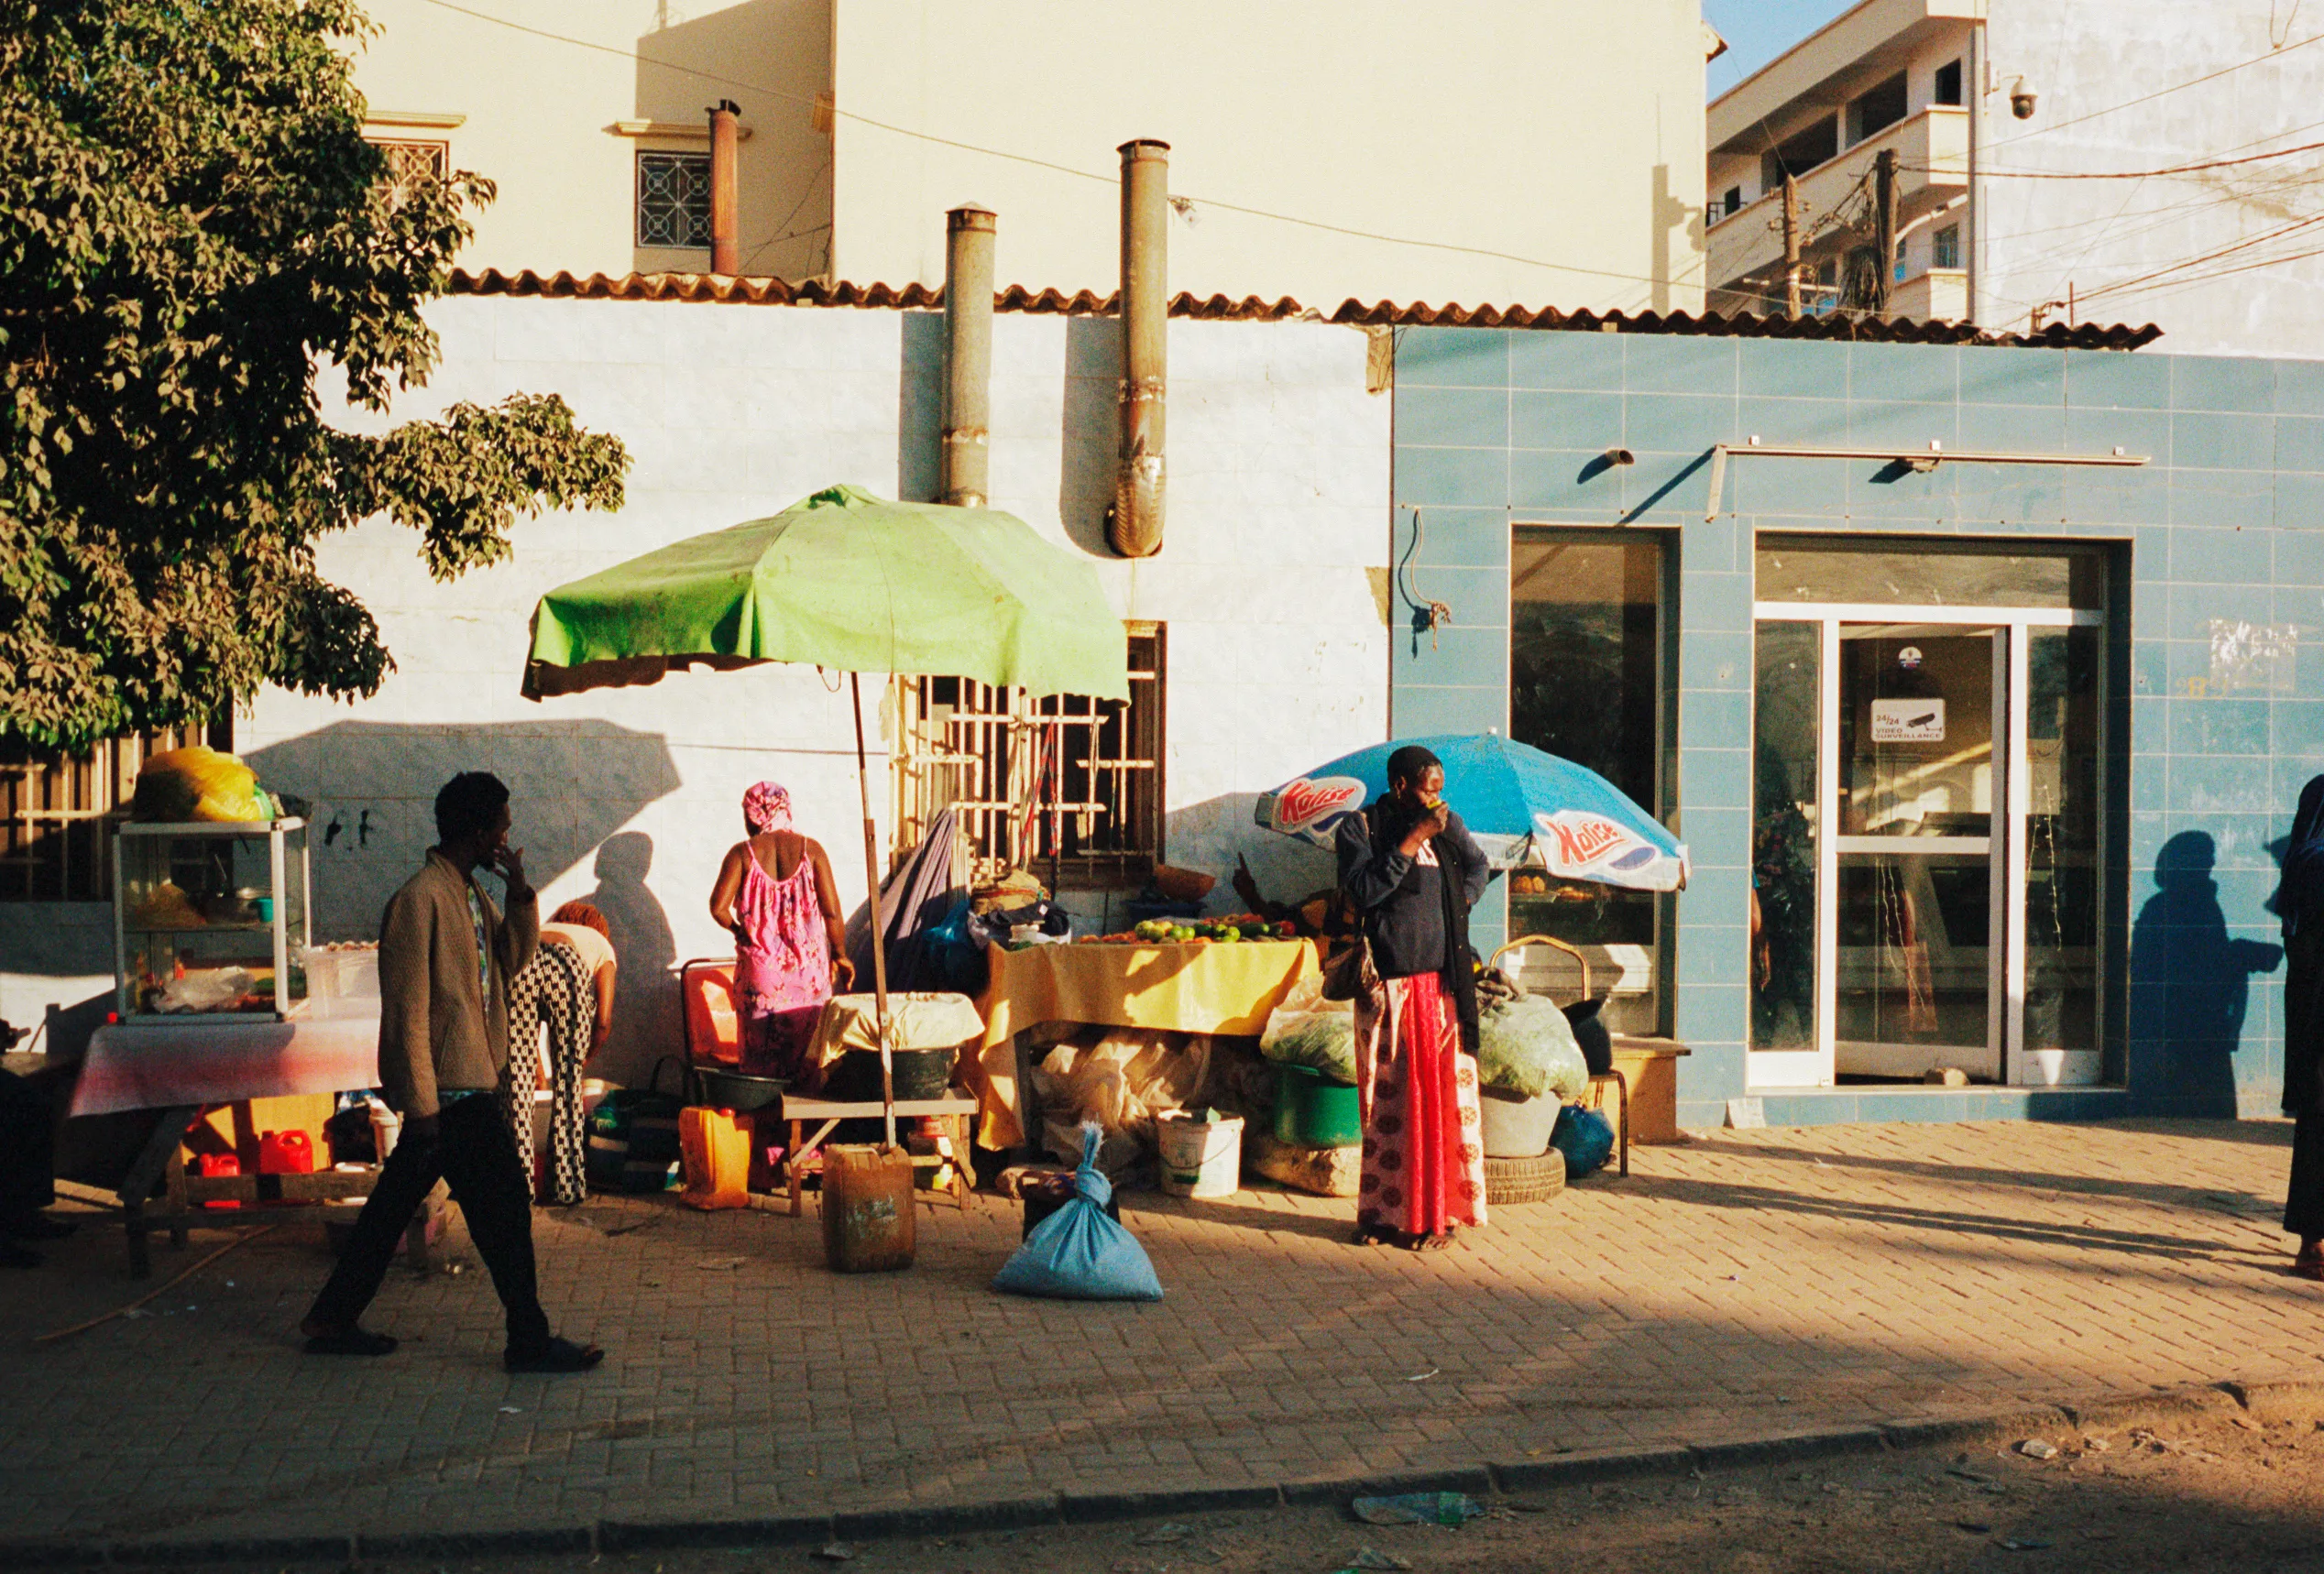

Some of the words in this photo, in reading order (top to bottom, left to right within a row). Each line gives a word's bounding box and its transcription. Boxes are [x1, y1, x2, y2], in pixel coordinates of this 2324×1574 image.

[1876, 715, 1900, 725] 24/24
[1281, 782, 1358, 824] Kalise
[1545, 819, 1620, 866] Kalise
